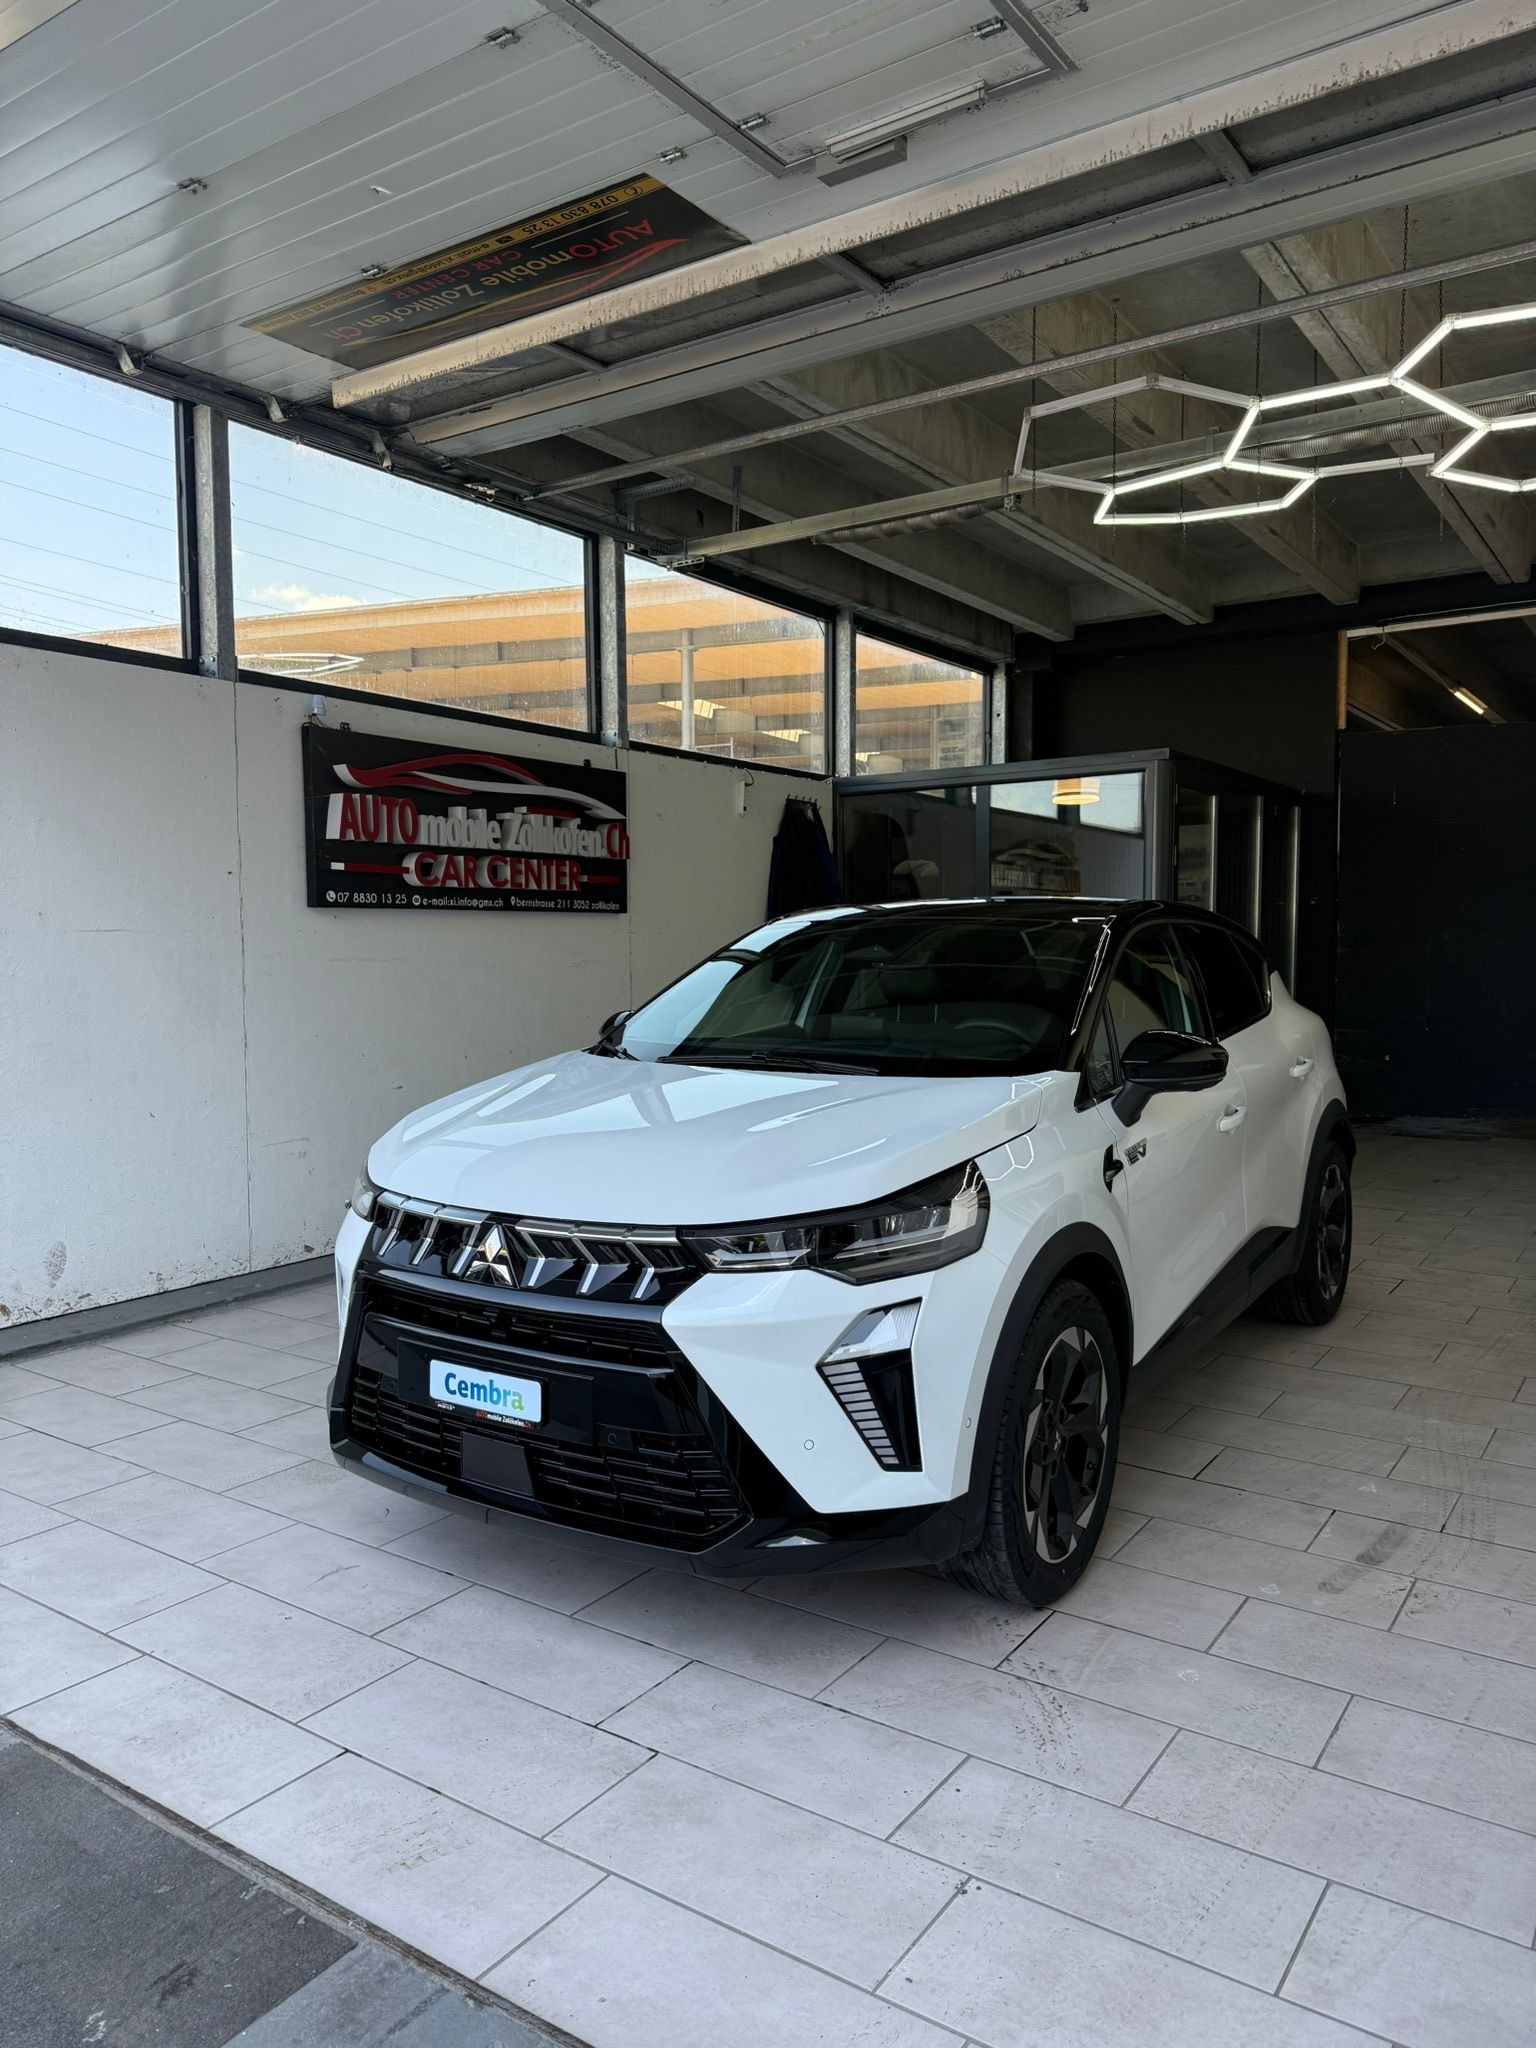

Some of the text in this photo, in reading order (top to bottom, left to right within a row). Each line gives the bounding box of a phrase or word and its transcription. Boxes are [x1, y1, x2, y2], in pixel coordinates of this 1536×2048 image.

[560, 207, 590, 220] 830
[589, 194, 619, 209] 078
[522, 223, 543, 235] 25
[541, 217, 561, 228] 13
[480, 219, 654, 286] AUTOmobile
[392, 250, 523, 300] CAR CENTER
[335, 792, 502, 851] AUTOmobile
[412, 851, 582, 891] CAR CENTER
[337, 891, 350, 903] 07
[353, 892, 378, 904] 8830
[381, 893, 392, 904] 13
[395, 893, 407, 904] 25
[516, 897, 555, 908] bernstrasse
[557, 898, 570, 909] 211
[572, 899, 590, 910] 3052
[591, 901, 620, 911] zollikofen
[444, 1372, 525, 1411] Cembra
